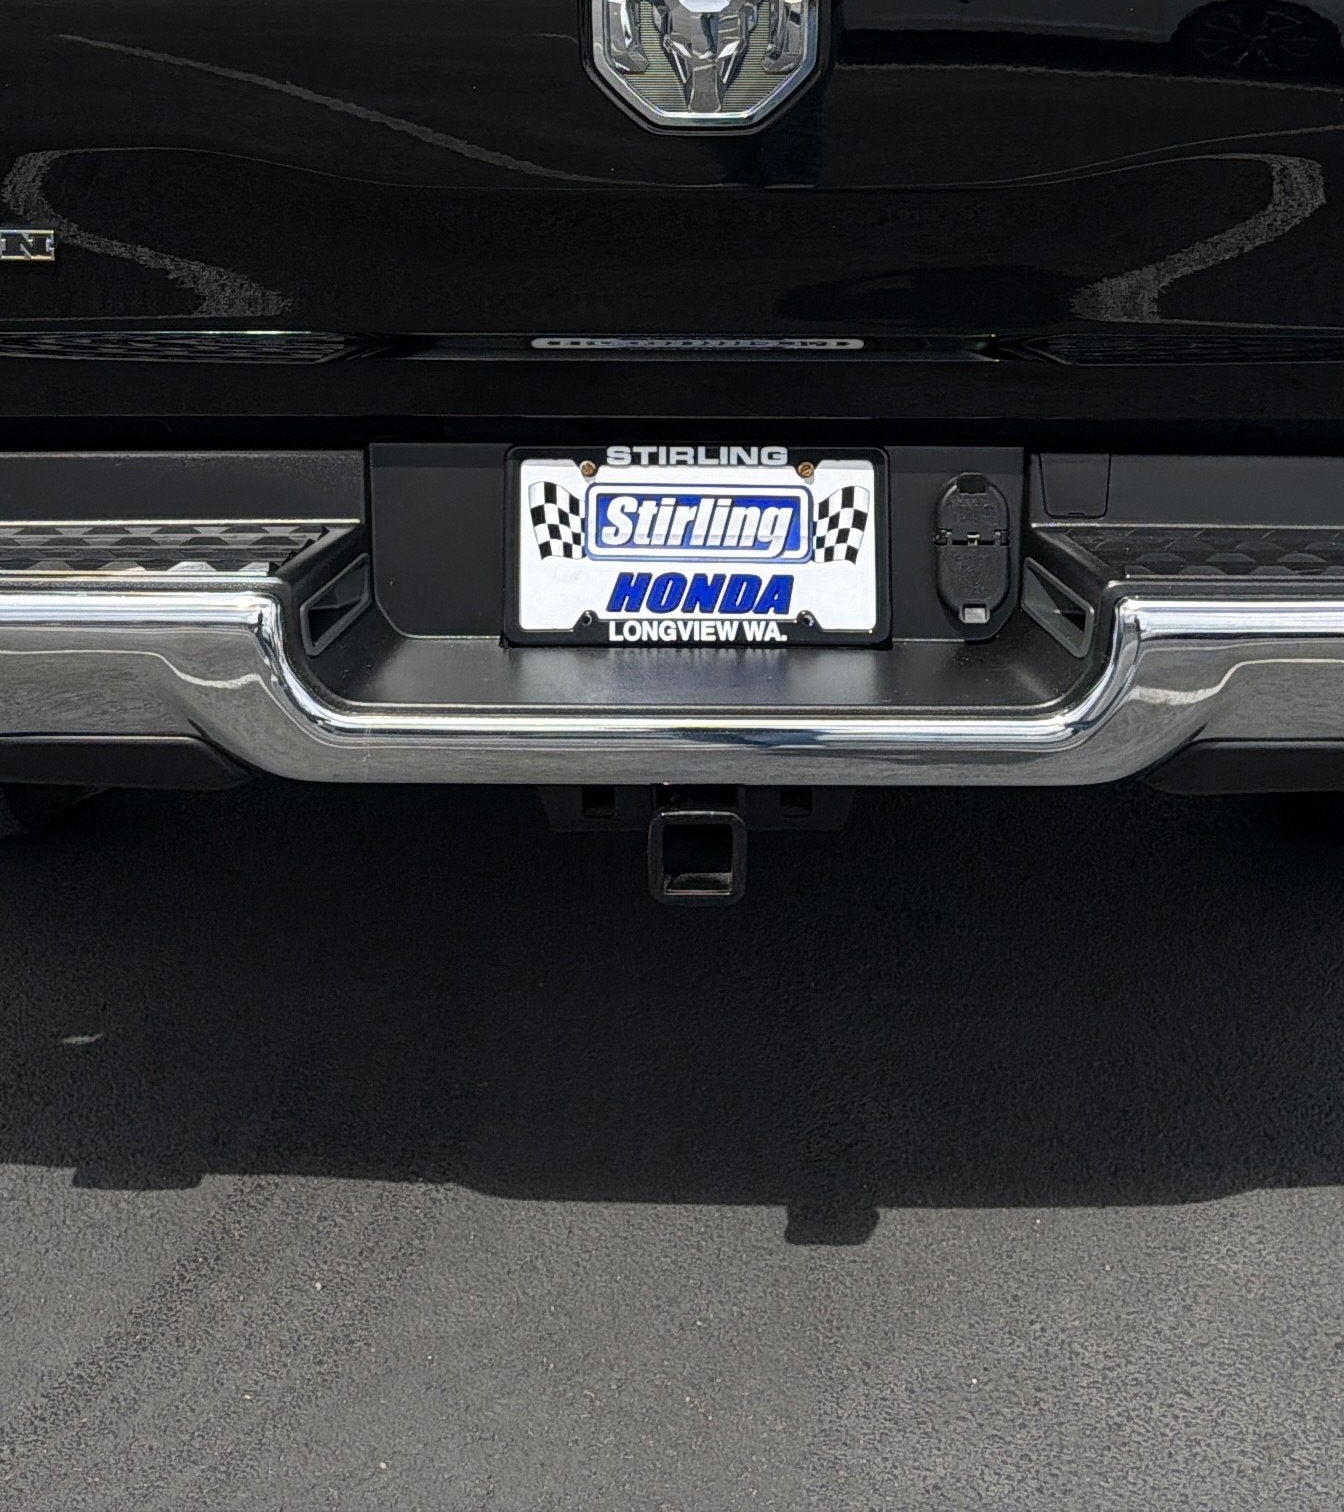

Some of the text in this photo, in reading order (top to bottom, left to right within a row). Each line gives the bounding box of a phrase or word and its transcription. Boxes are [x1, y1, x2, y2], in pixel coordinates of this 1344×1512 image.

[606, 445, 789, 466] STIRLING
[601, 496, 794, 559] Stirling
[606, 572, 795, 615] HONDA
[608, 620, 788, 642] LONGVIEW WA.
